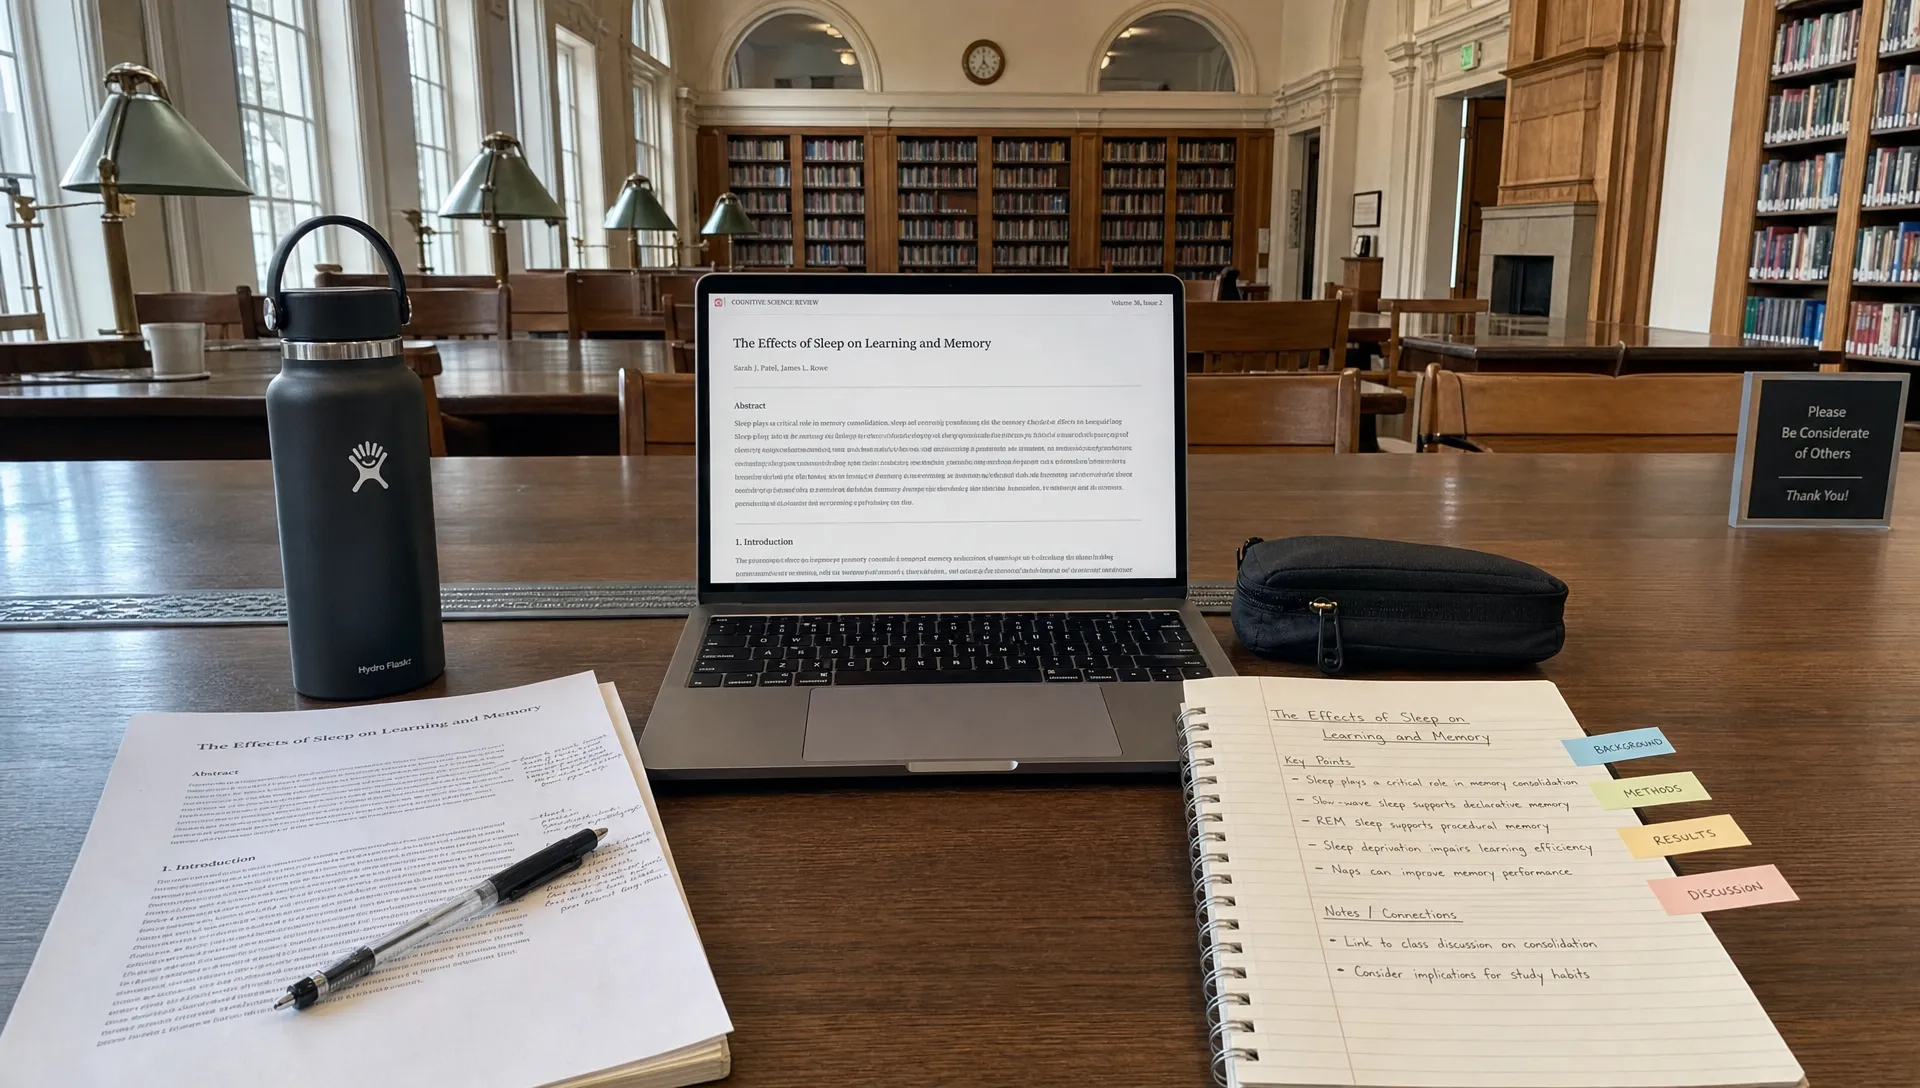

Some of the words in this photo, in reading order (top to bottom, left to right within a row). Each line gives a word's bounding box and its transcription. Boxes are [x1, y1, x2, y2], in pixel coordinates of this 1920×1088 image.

[733, 338, 755, 349] The
[758, 337, 797, 349] Effects
[799, 337, 813, 349] of
[814, 337, 844, 351] Sleep
[847, 340, 862, 349] on
[865, 337, 917, 351] Learning
[919, 338, 941, 349] and
[944, 338, 991, 351] Memory
[733, 364, 753, 372] Sarah
[780, 364, 801, 373] James
[810, 364, 829, 372] Rowe
[734, 401, 766, 410] Abstract
[1808, 405, 1847, 418] Please
[734, 420, 751, 428] Sleep
[1781, 426, 1797, 439] Be
[1799, 426, 1870, 439] Considerate
[1794, 447, 1809, 459] of
[1810, 447, 1851, 459] Others
[1786, 489, 1821, 501] Thank
[1824, 489, 1849, 501] You!
[735, 538, 743, 546] 1.
[744, 537, 794, 546] Introduction
[358, 664, 385, 675] Hydro
[1270, 709, 1299, 720] The
[1308, 710, 1365, 722] Effects
[1375, 712, 1389, 722] of
[1400, 712, 1439, 727] Sleep
[197, 742, 228, 751] The
[233, 740, 289, 749] Effects
[293, 736, 311, 744] of
[313, 733, 354, 743] Sleep
[358, 730, 377, 738] on
[382, 720, 449, 735] Learning
[452, 715, 479, 726] and
[483, 704, 542, 721] Memory
[1322, 728, 1386, 745] Learning
[1396, 731, 1422, 741] and
[1432, 731, 1491, 746] Memory
[1593, 738, 1663, 755] BACKGROUND
[1284, 755, 1306, 769] Key
[1315, 755, 1352, 766] Points
[191, 769, 239, 777] Abstract
[1306, 775, 1335, 788] Sleep
[1341, 776, 1367, 788] plays
[1386, 778, 1423, 787] critical
[1429, 778, 1448, 787] role
[1453, 779, 1464, 787] in
[1470, 780, 1507, 791] memory
[1512, 777, 1579, 787] consolidation
[1623, 784, 1683, 800] METHODS
[1379, 798, 1406, 811] sleep
[1413, 799, 1456, 811] supports
[1463, 799, 1522, 809] declarative
[1529, 801, 1570, 812] memory
[1316, 815, 1346, 826] REM
[1355, 817, 1383, 832] sleep
[1390, 820, 1433, 832] supports
[1440, 820, 1497, 833] procedural
[1506, 822, 1550, 834] memory
[1653, 829, 1717, 846] RESULTS
[1323, 840, 1354, 855] Sleep
[1361, 841, 1422, 855] deprivation
[1429, 844, 1471, 857] impairs
[1478, 843, 1528, 857] learning
[1534, 842, 1593, 857] efficiency
[176, 855, 256, 872] Introduction
[1331, 864, 1361, 878] Naps
[1401, 867, 1445, 880] improve
[1453, 870, 1496, 882] memory
[1502, 866, 1573, 881] performance
[1324, 904, 1360, 918] Notes
[1382, 907, 1457, 920] Connections
[1344, 935, 1373, 947] Link
[1380, 937, 1393, 948] to
[1401, 937, 1429, 949] class
[1437, 937, 1493, 949] discussion
[1523, 937, 1598, 949] consolidation
[1354, 965, 1403, 979] Consider
[1413, 968, 1477, 984] implications
[1483, 967, 1502, 980] for
[1510, 968, 1544, 987] study
[1551, 968, 1590, 980] habits
